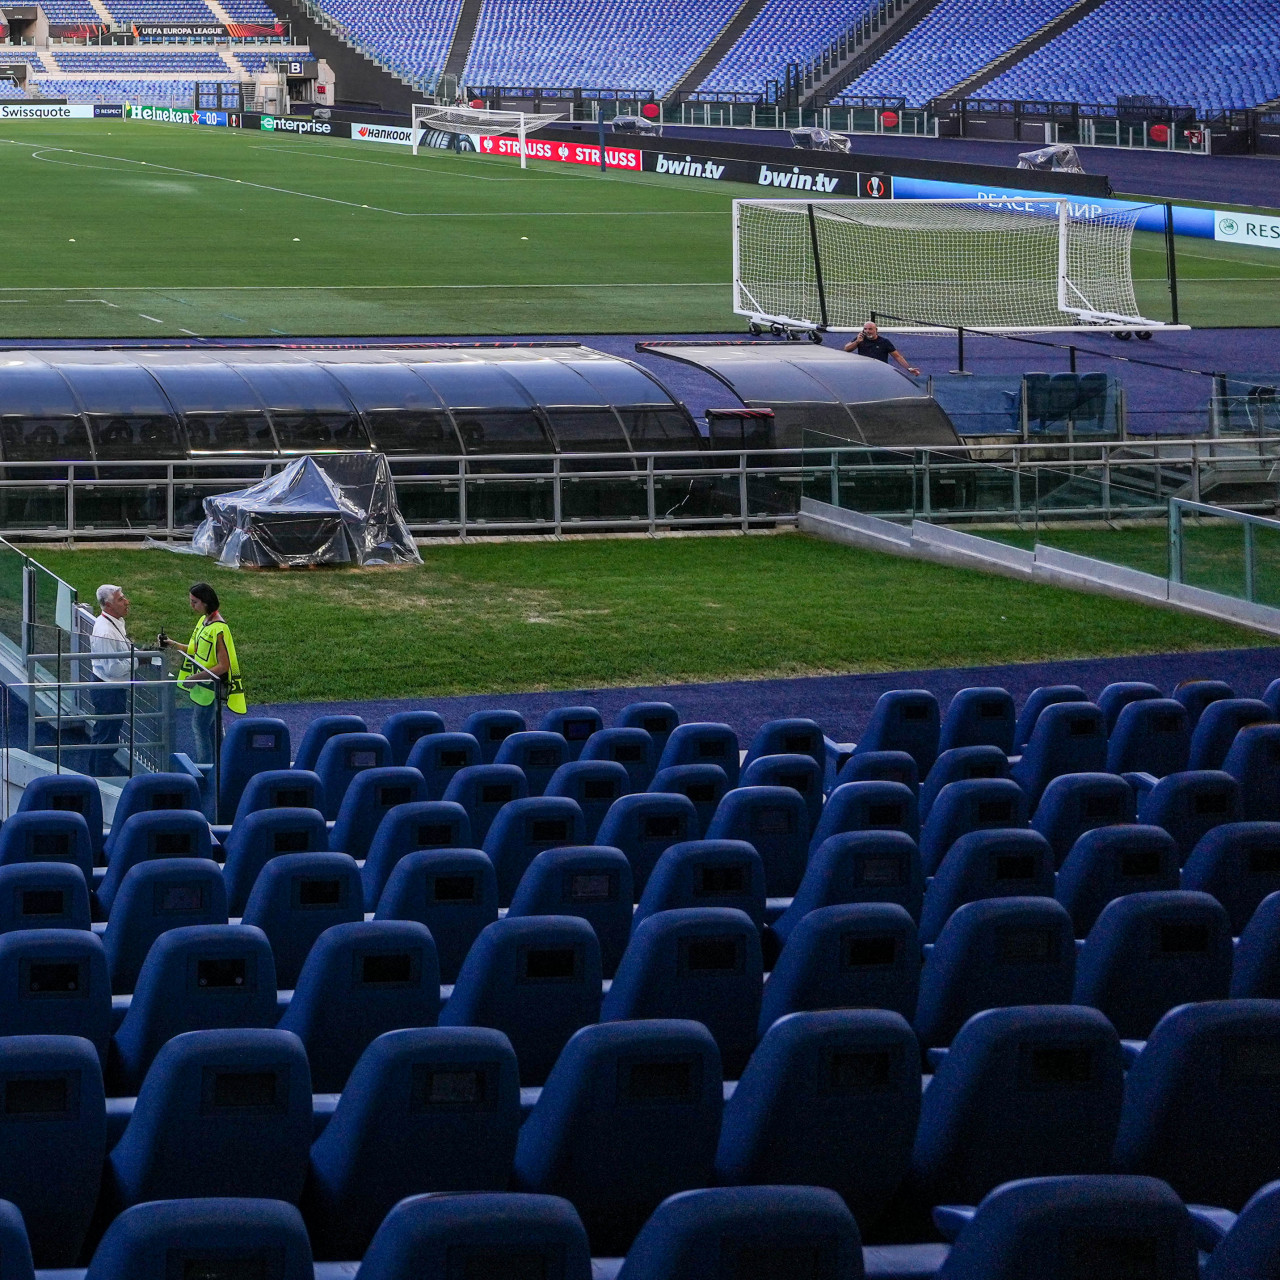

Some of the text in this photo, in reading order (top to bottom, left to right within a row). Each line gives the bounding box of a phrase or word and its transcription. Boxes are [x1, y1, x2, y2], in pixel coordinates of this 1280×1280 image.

[163, 27, 192, 35] EUROPA
[291, 62, 301, 73] B
[2, 106, 71, 118] Swissquote
[131, 105, 190, 124] Heineken
[261, 117, 331, 134] enterprise
[655, 154, 726, 180] bwin.tv
[758, 164, 838, 193] bwin.tv
[977, 191, 1035, 213] PEACE
[1246, 222, 1280, 240] RES
